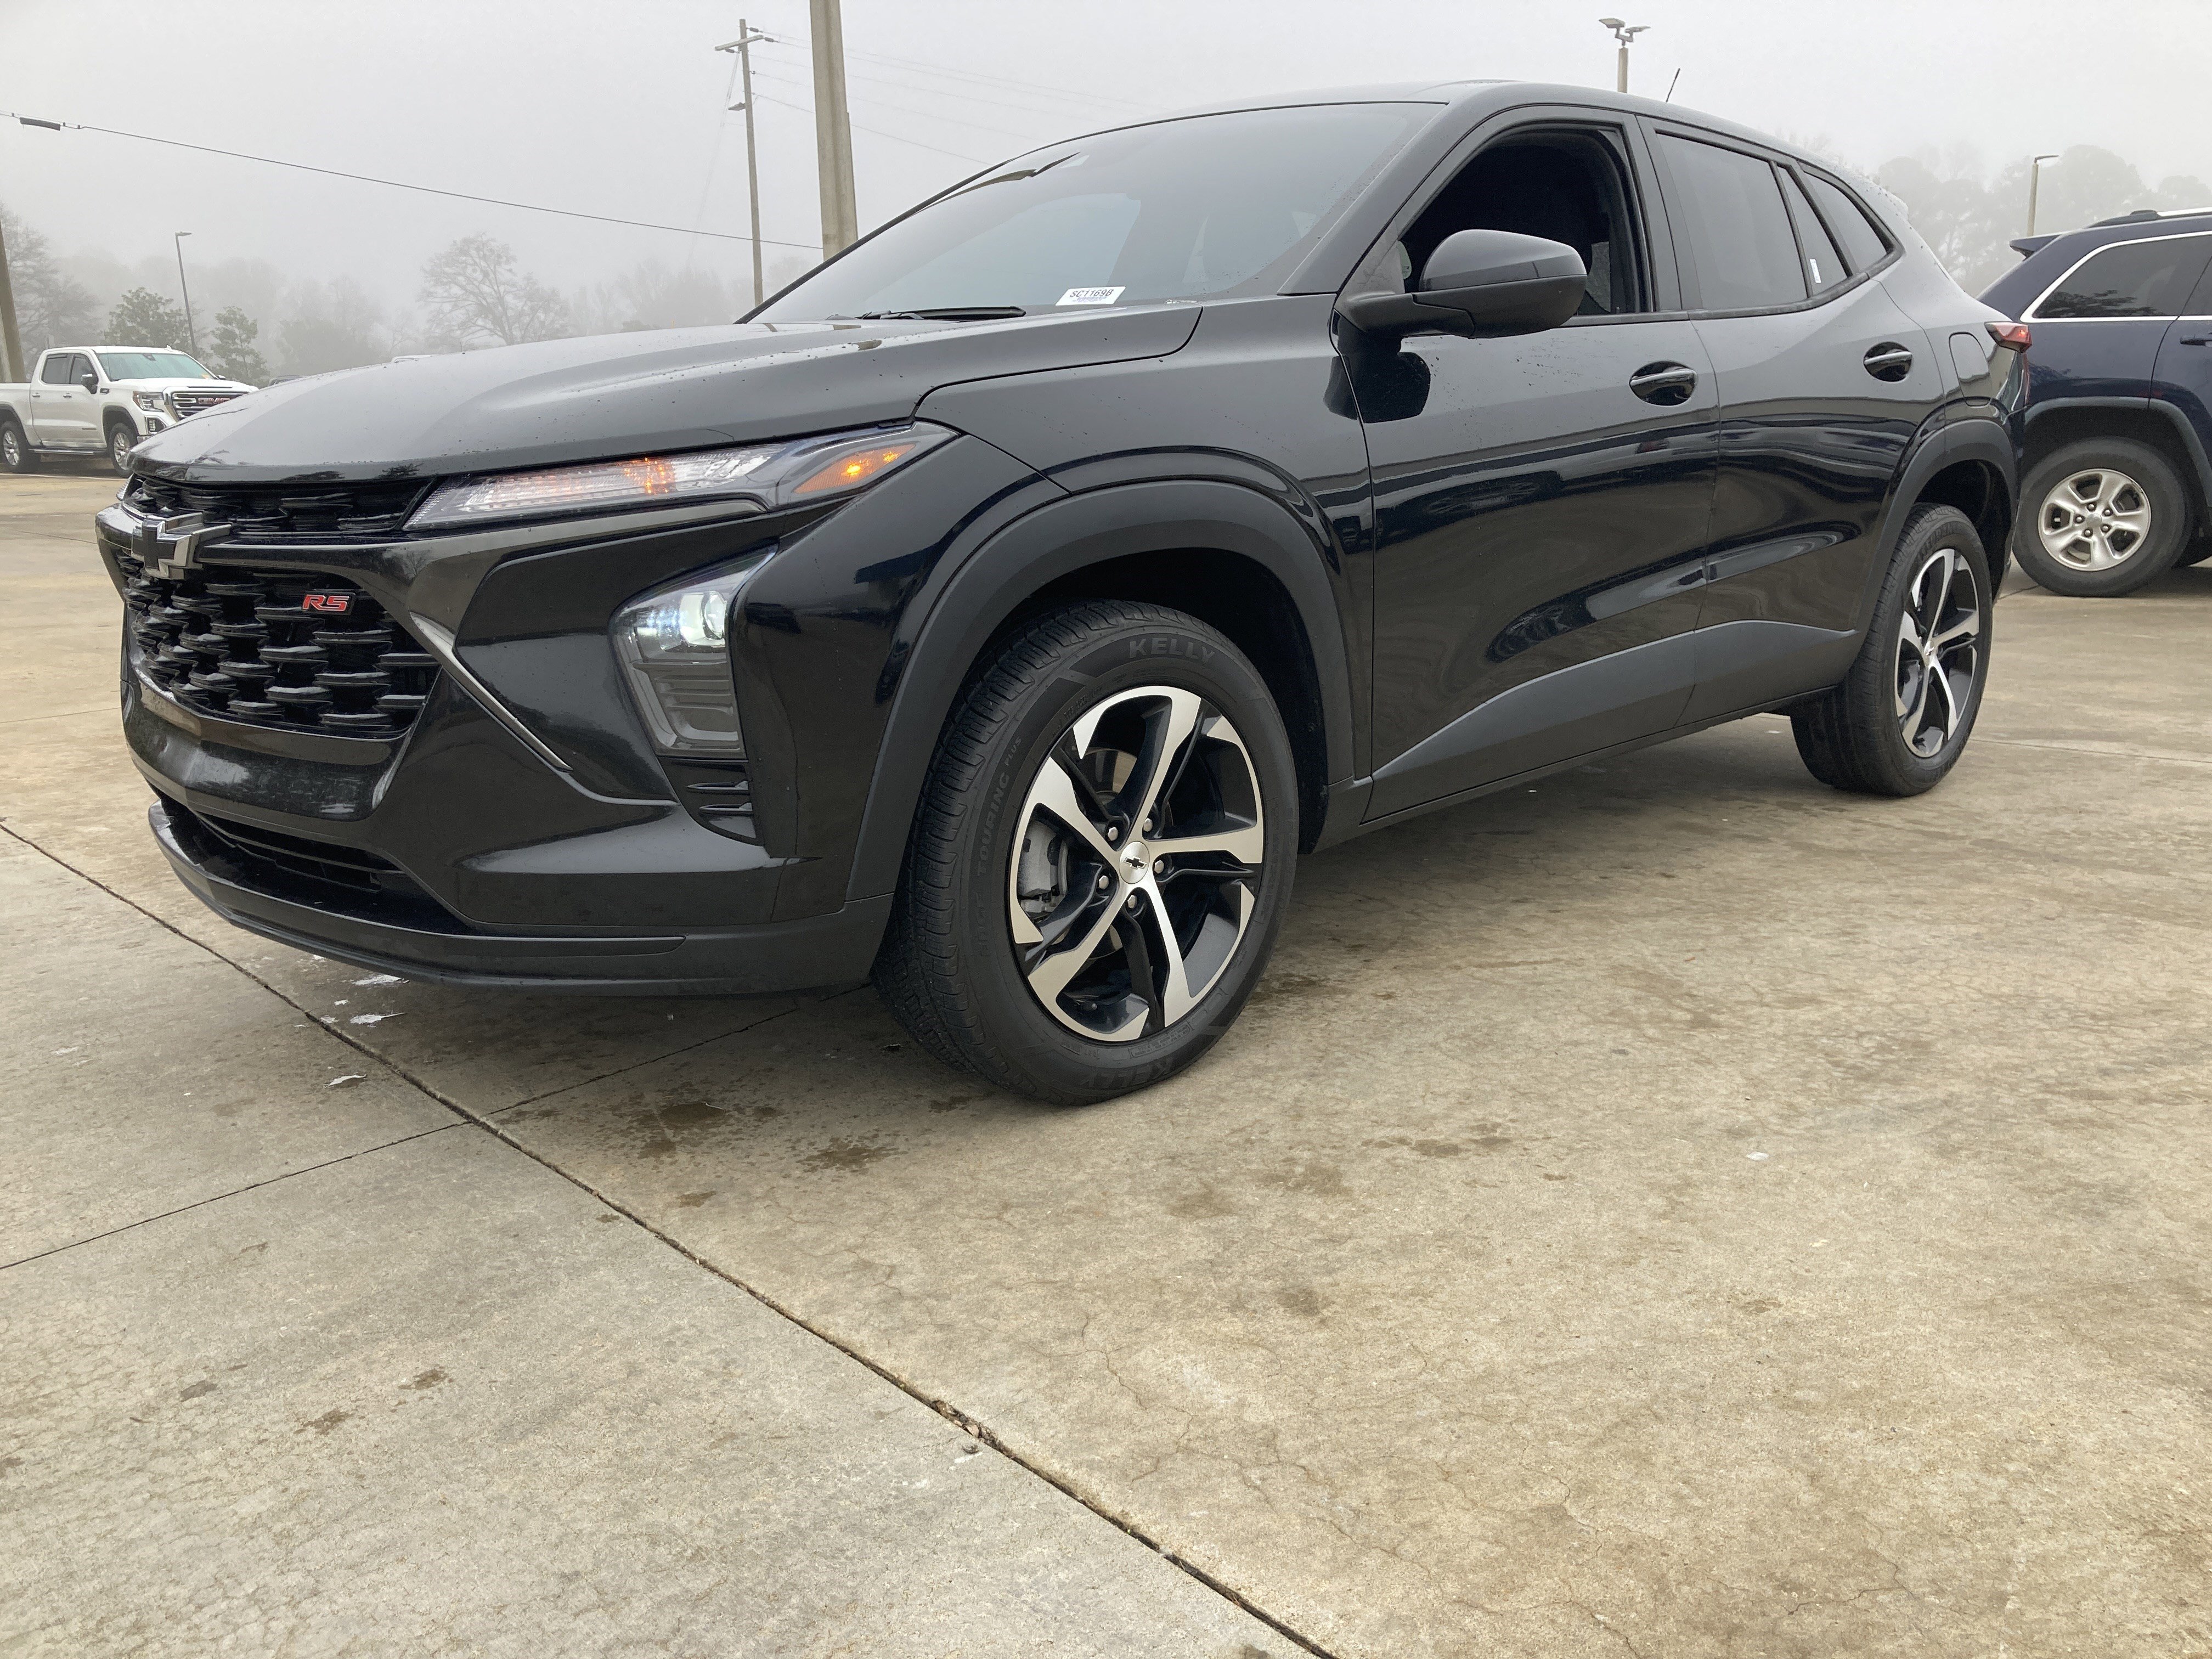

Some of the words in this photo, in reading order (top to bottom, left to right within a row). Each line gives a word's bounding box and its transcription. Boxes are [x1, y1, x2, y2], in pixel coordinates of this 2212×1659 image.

[1069, 289, 1114, 298] SC1169B
[302, 594, 350, 612] RS
[1128, 636, 1216, 664] KELLY
[977, 771, 1010, 877] TOURING
[1005, 737, 1022, 768] PLUS
